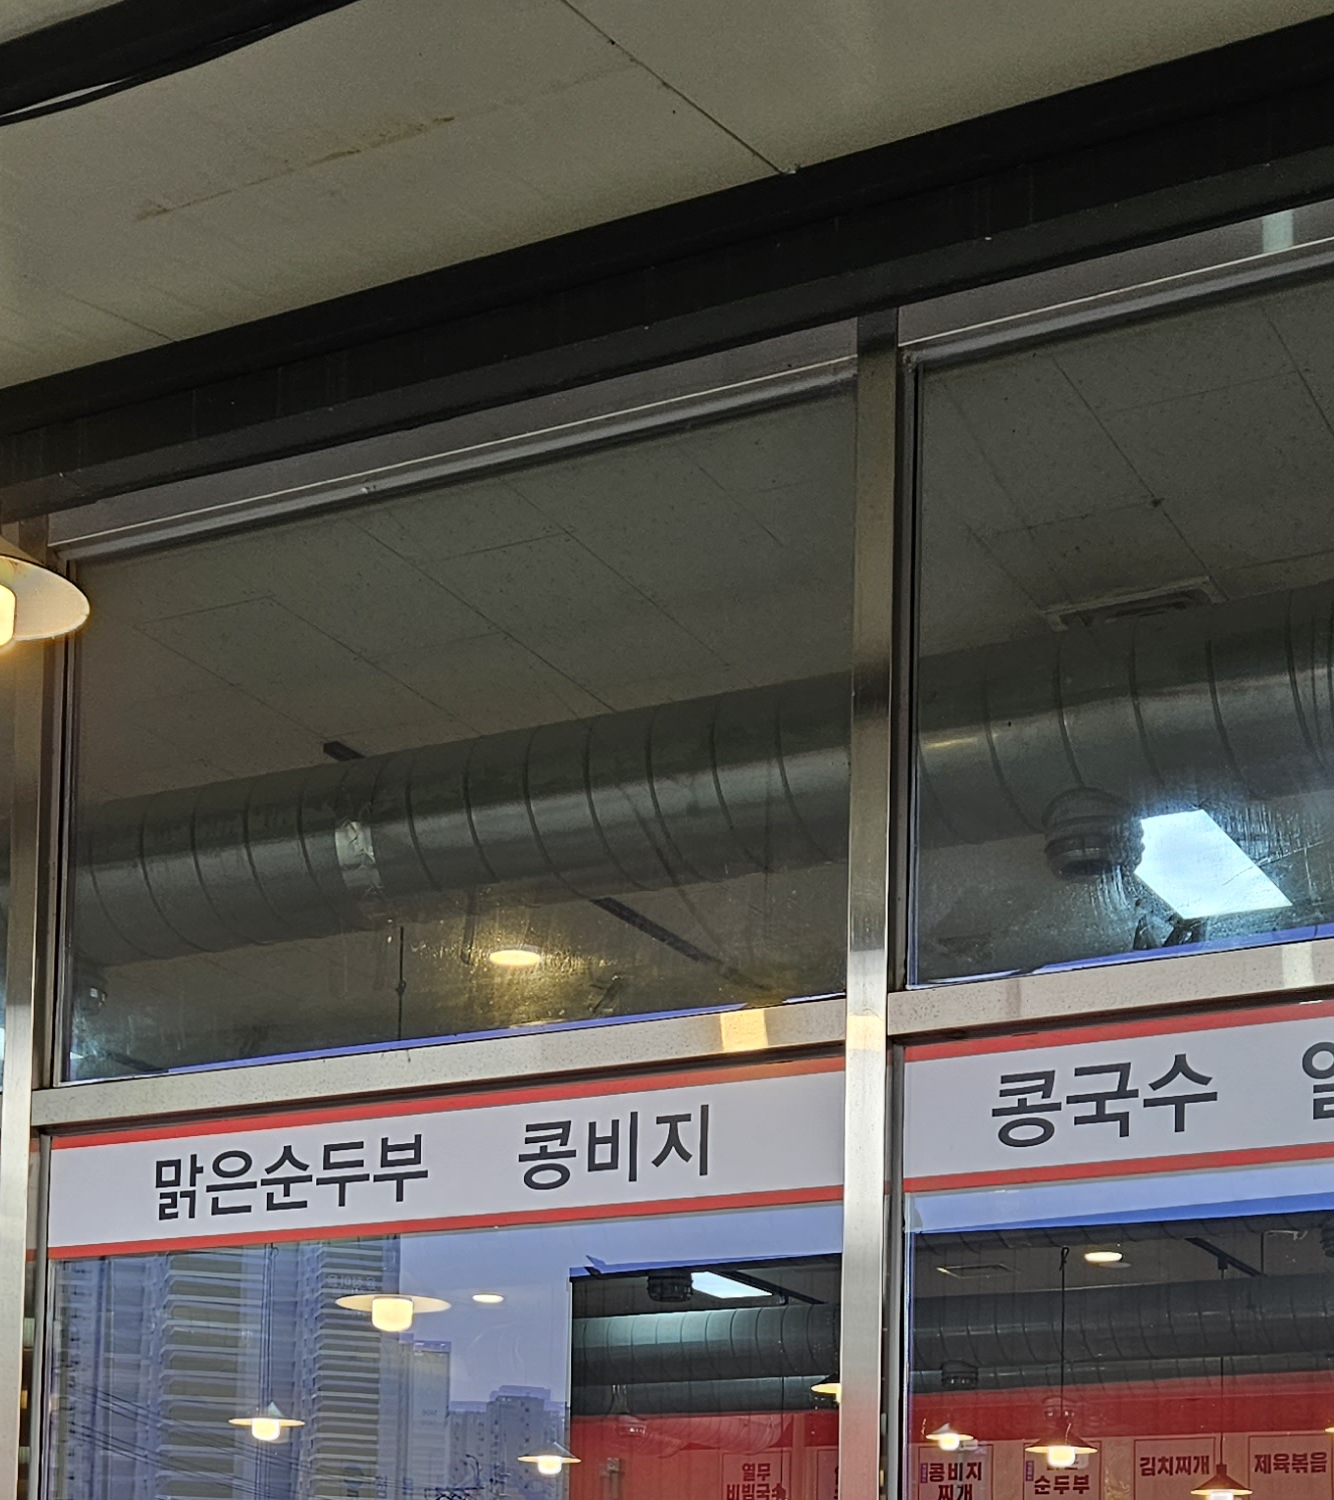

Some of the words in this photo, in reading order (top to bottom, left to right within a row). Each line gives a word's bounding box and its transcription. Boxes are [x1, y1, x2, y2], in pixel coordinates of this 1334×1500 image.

[991, 1053, 1218, 1148] 콩국수
[155, 1133, 429, 1220] 맑은순두부
[518, 1104, 709, 1191] 콩비지
[741, 1462, 771, 1482] 열무
[929, 1461, 982, 1482] 콩비지
[1139, 1453, 1210, 1477] 김치찌개
[1253, 1451, 1329, 1475] 제육볶음
[1034, 1475, 1090, 1495] 순두부
